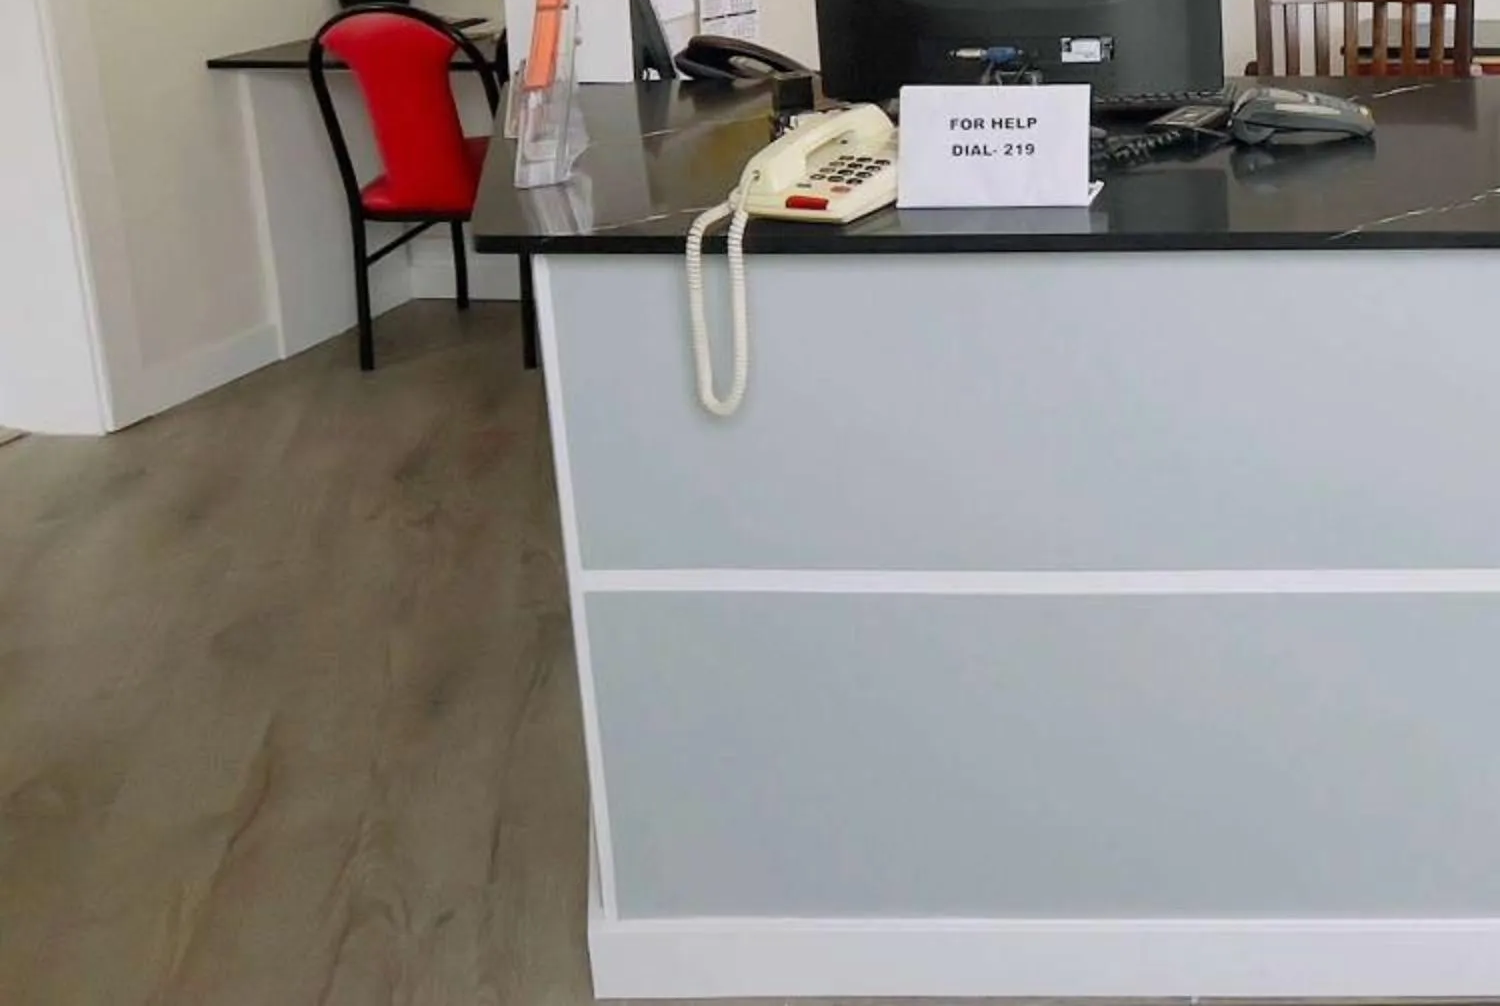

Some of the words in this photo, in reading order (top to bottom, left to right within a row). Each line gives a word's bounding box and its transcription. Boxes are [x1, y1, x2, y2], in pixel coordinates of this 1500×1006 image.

[949, 117, 985, 131] FOR
[991, 116, 1038, 130] HELP
[951, 144, 998, 157] DIAL-
[1003, 143, 1035, 156] 219
